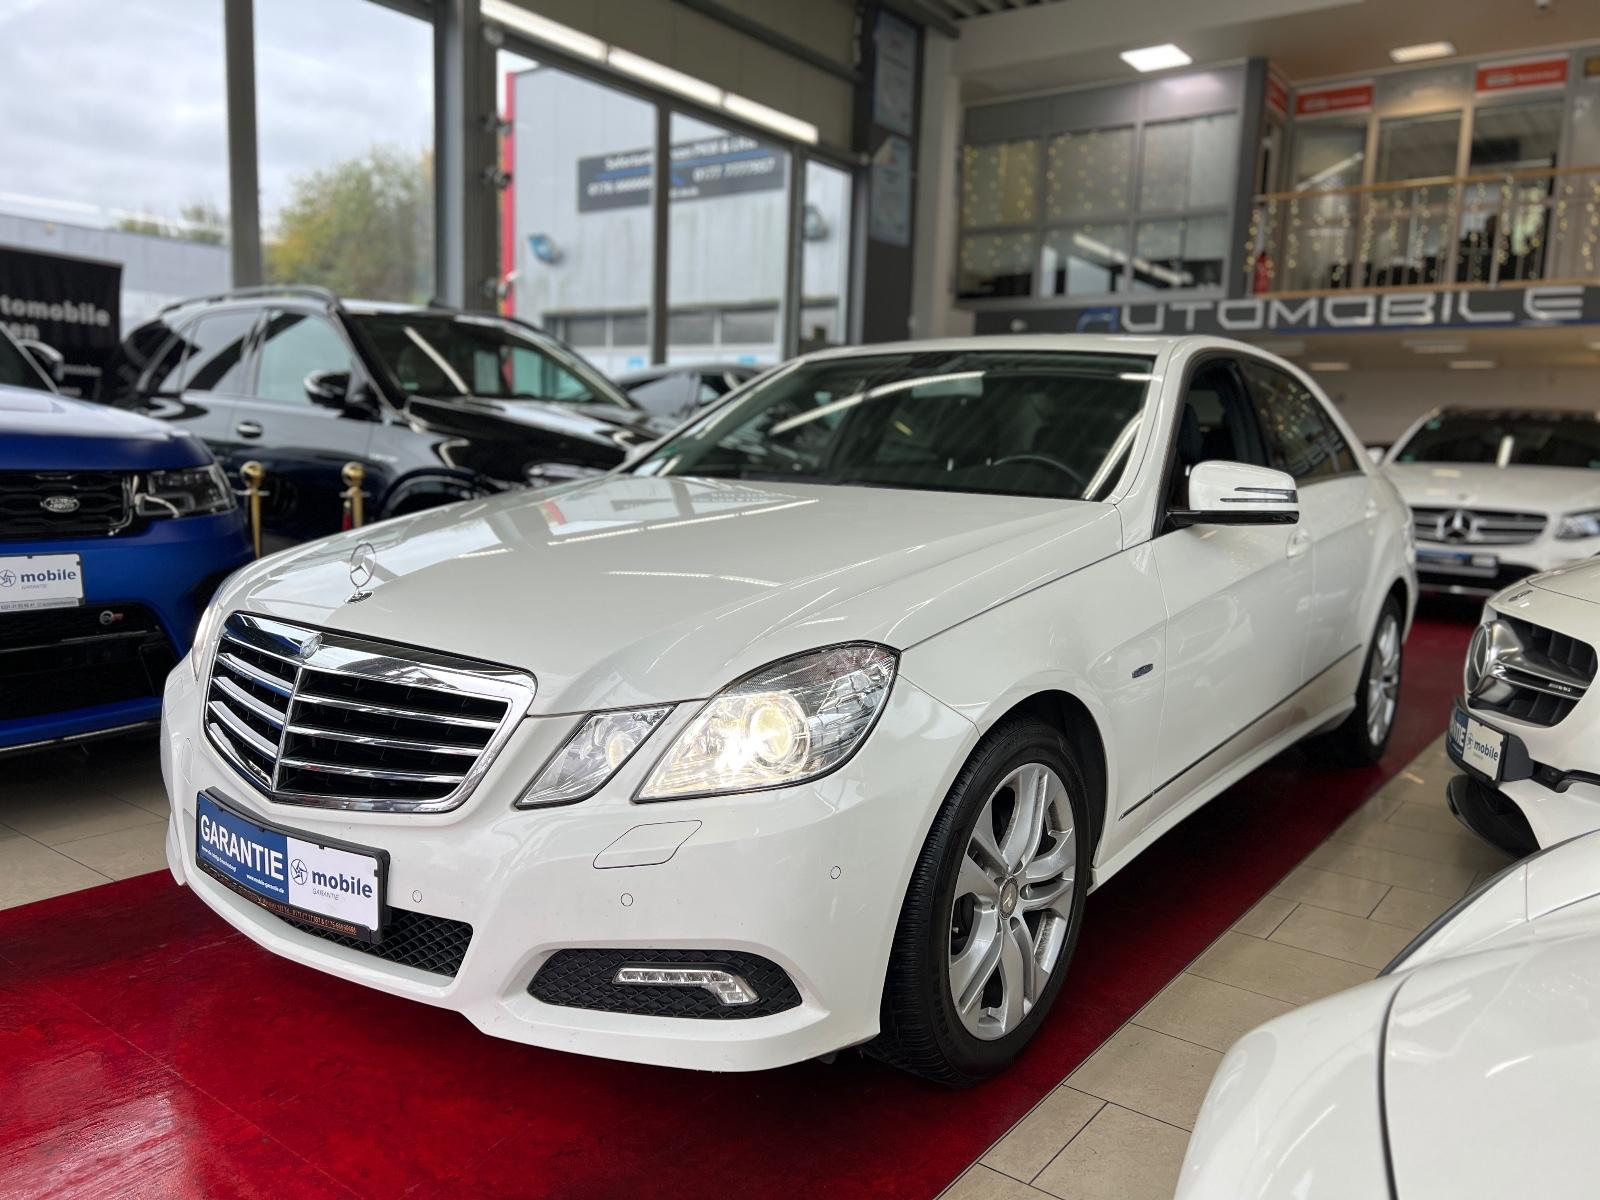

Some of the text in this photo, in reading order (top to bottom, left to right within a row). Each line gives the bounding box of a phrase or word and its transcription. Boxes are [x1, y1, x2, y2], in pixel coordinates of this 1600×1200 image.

[0, 294, 111, 327] tomobile
[1077, 286, 1585, 332] AUTOMOBILE
[20, 568, 77, 583] mobile
[1473, 740, 1499, 761] mobile
[200, 814, 285, 881] GARANTIE
[312, 870, 373, 899] mobile
[312, 888, 340, 901] GARANTIE
